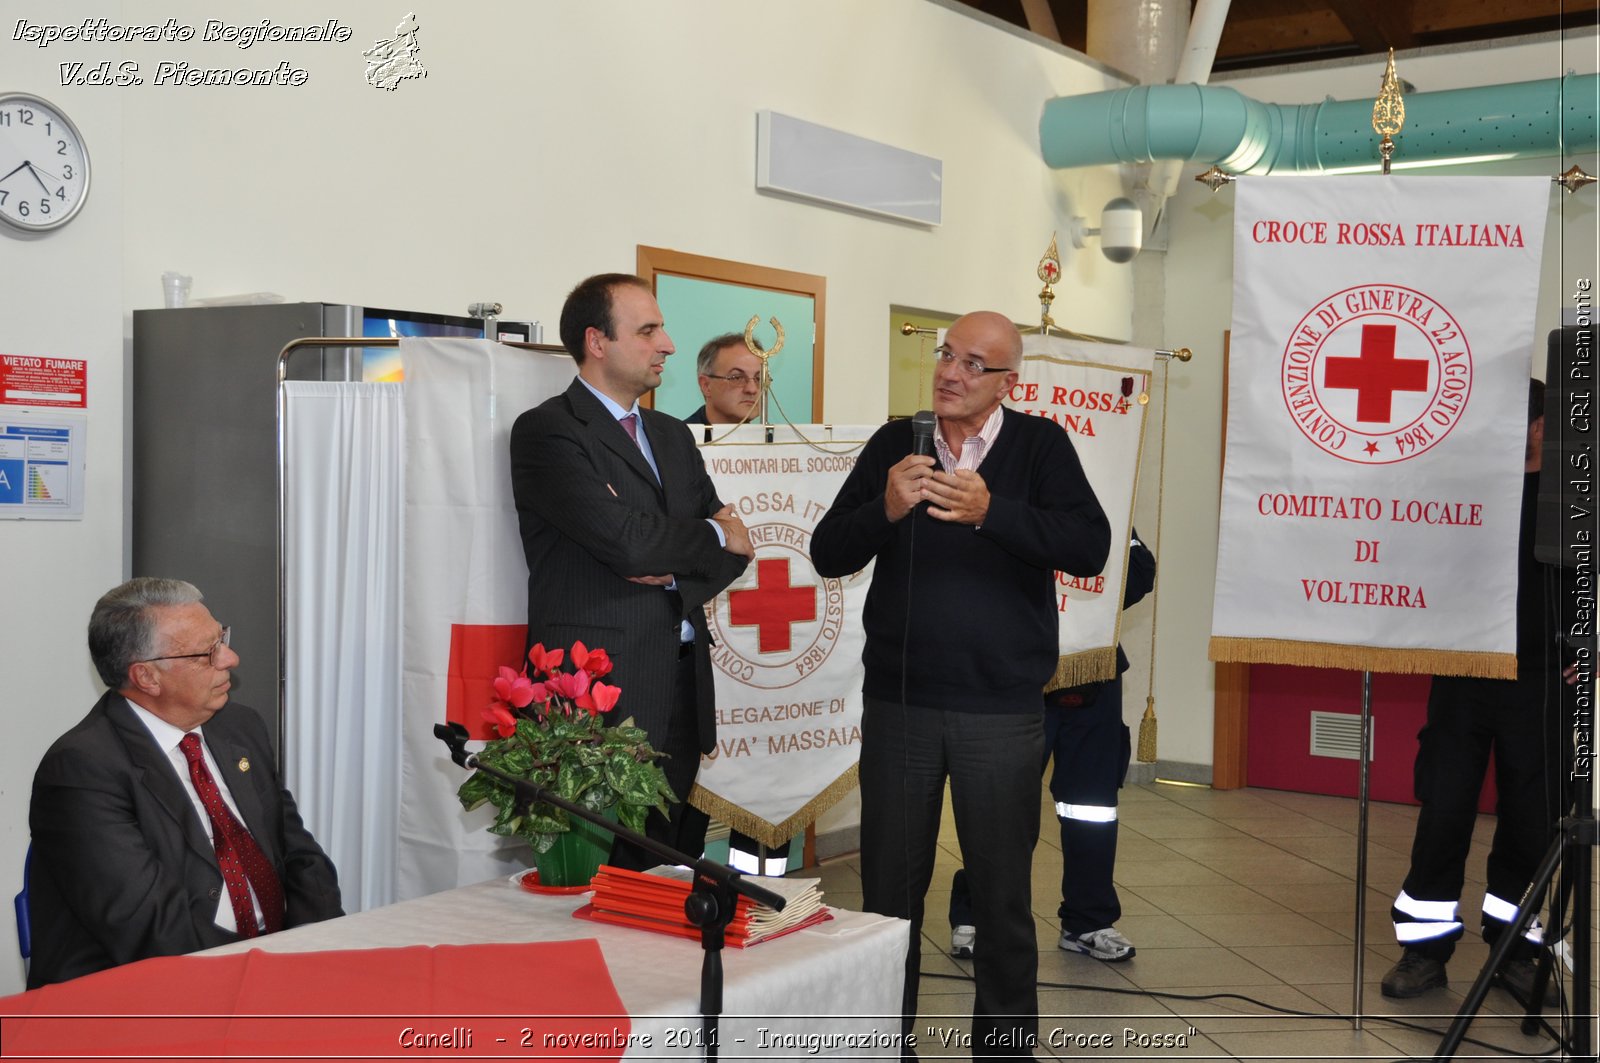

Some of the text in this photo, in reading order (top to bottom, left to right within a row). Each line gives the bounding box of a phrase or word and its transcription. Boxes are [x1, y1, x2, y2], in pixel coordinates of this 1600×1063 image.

[17, 108, 34, 126] 12
[45, 122, 51, 136] 1
[57, 140, 67, 156] 2
[63, 164, 73, 180] 3
[55, 185, 66, 201] 4
[19, 201, 30, 216] 6
[40, 198, 51, 214] 5
[1252, 220, 1525, 248] CROCE ROSSA ITALIANA
[3, 356, 42, 368] VIETATO
[45, 359, 84, 371] FUMARE
[1287, 289, 1468, 455] CONVENZIONE DI GINEVRA 22 AGOSTO 1864
[1050, 386, 1128, 415] ROSSA
[712, 458, 778, 474] VOLONTARI
[781, 458, 803, 473] DEL
[1258, 493, 1484, 526] COMITATO LOCALE
[1354, 540, 1380, 563] DI
[1055, 570, 1105, 593] CALE
[1301, 579, 1427, 608] VOLTERRA
[822, 577, 841, 641] GOSTO
[795, 645, 826, 676] 1864
[829, 698, 846, 715] DI
[768, 726, 862, 755] MASSAIA
